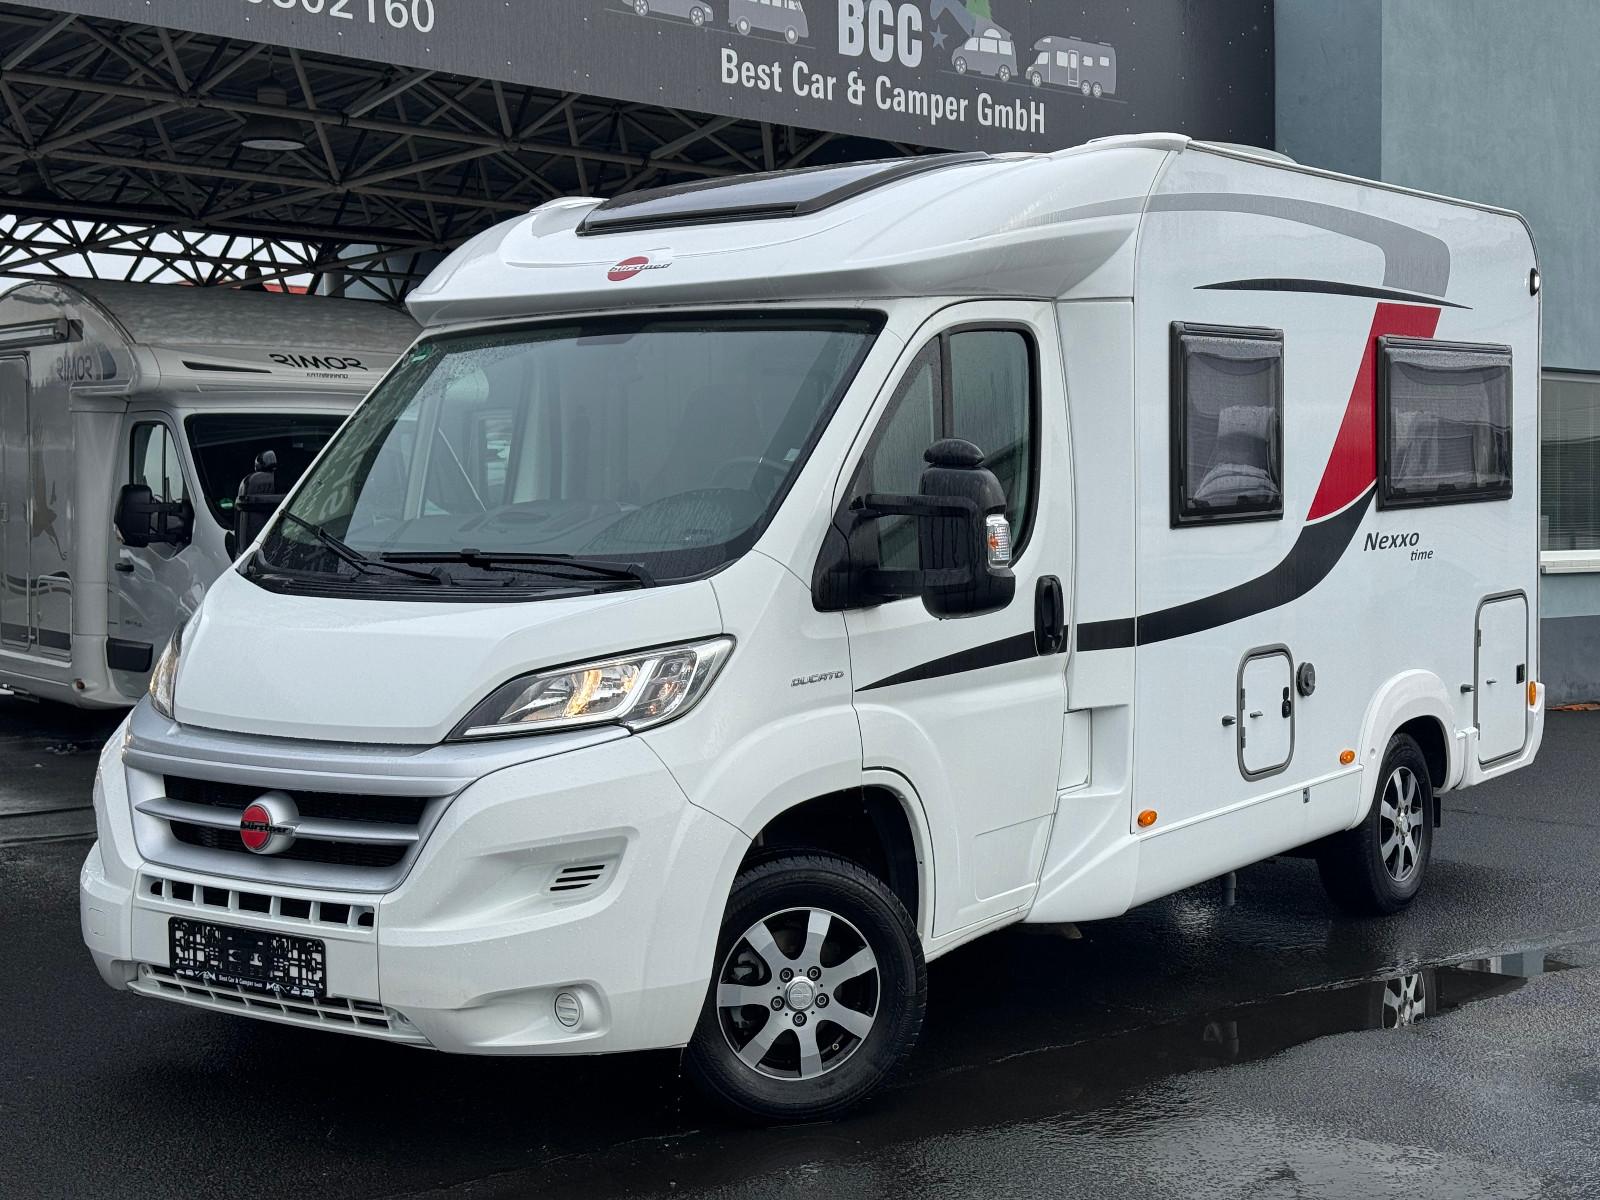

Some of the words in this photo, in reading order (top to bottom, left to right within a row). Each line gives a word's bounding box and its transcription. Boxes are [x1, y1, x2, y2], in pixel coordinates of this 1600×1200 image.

[246, 0, 435, 33] 2160
[838, 0, 923, 67] BCC
[721, 47, 783, 93] Best
[792, 60, 837, 101] Car
[847, 70, 866, 105] &
[875, 75, 968, 125] Camper
[976, 92, 1045, 134] GmbH
[268, 353, 369, 371] RIMOR
[1363, 531, 1420, 551] Nexxo
[1410, 548, 1434, 561] time
[790, 670, 845, 687] DUCATO
